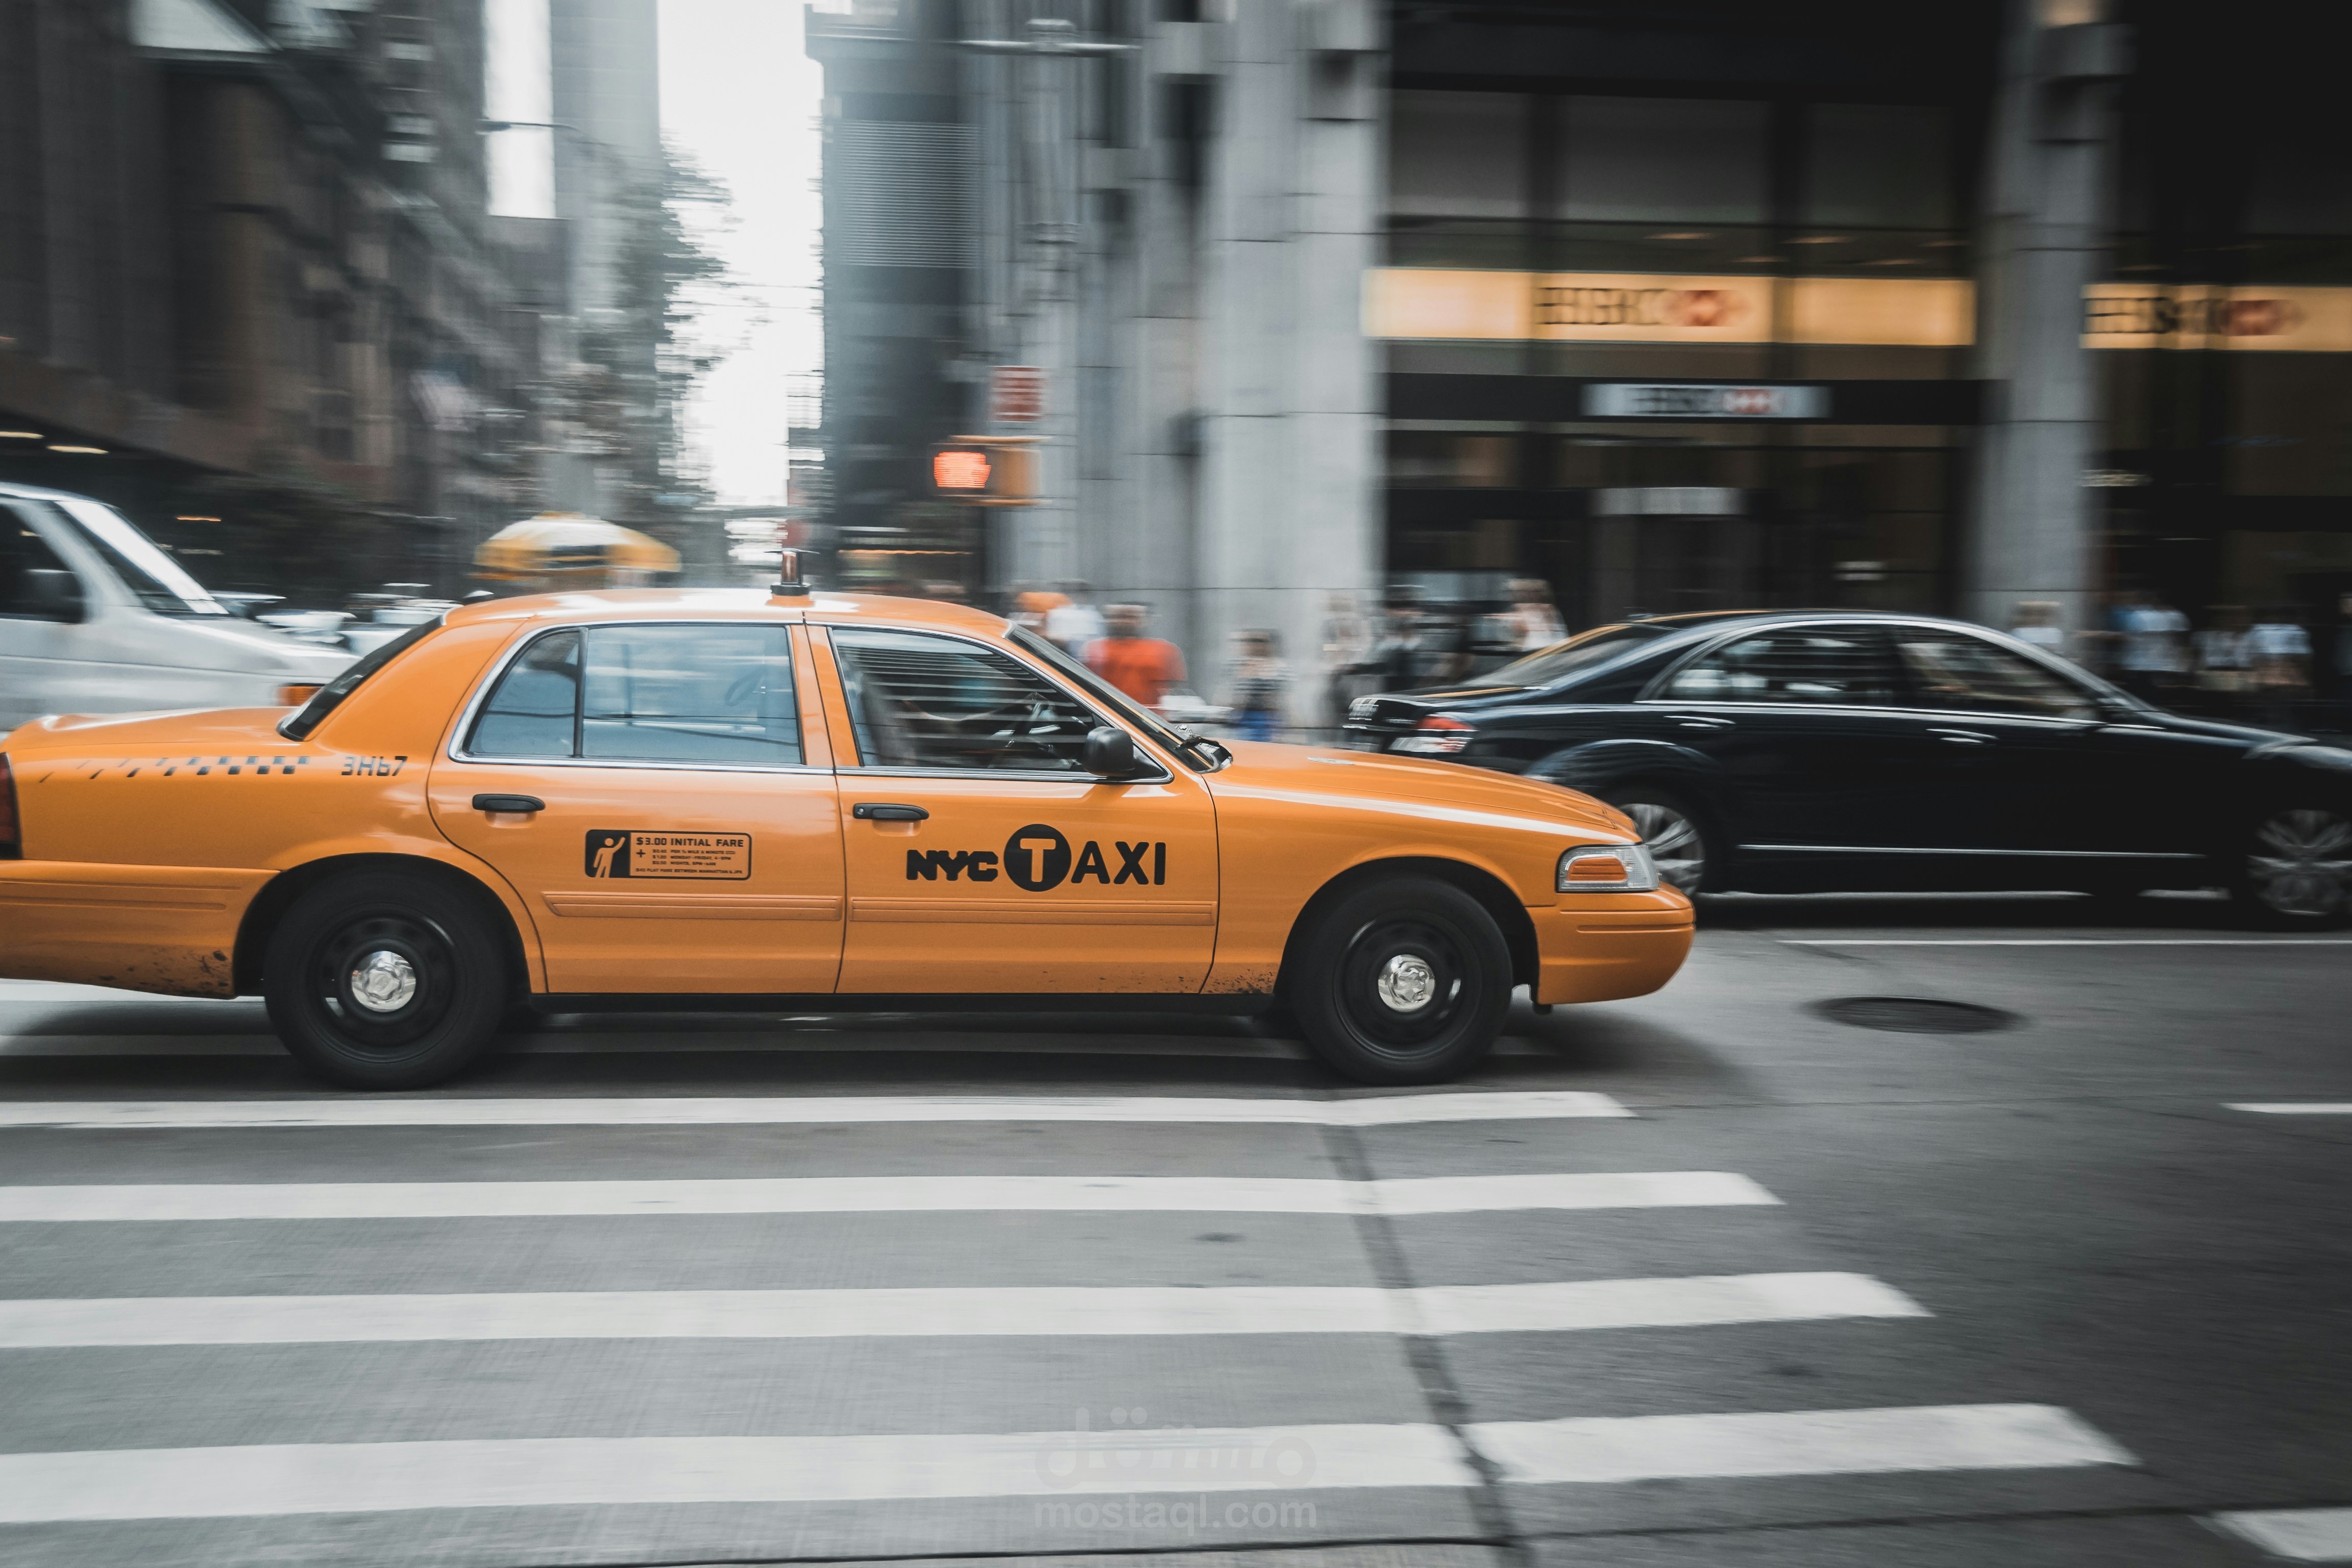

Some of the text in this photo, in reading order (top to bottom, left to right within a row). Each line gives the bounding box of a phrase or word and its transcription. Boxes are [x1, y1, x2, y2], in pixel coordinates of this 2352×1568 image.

[636, 837, 667, 845] $3.00
[671, 838, 711, 846] INITIAL
[906, 835, 1166, 886] NYC TAXI
